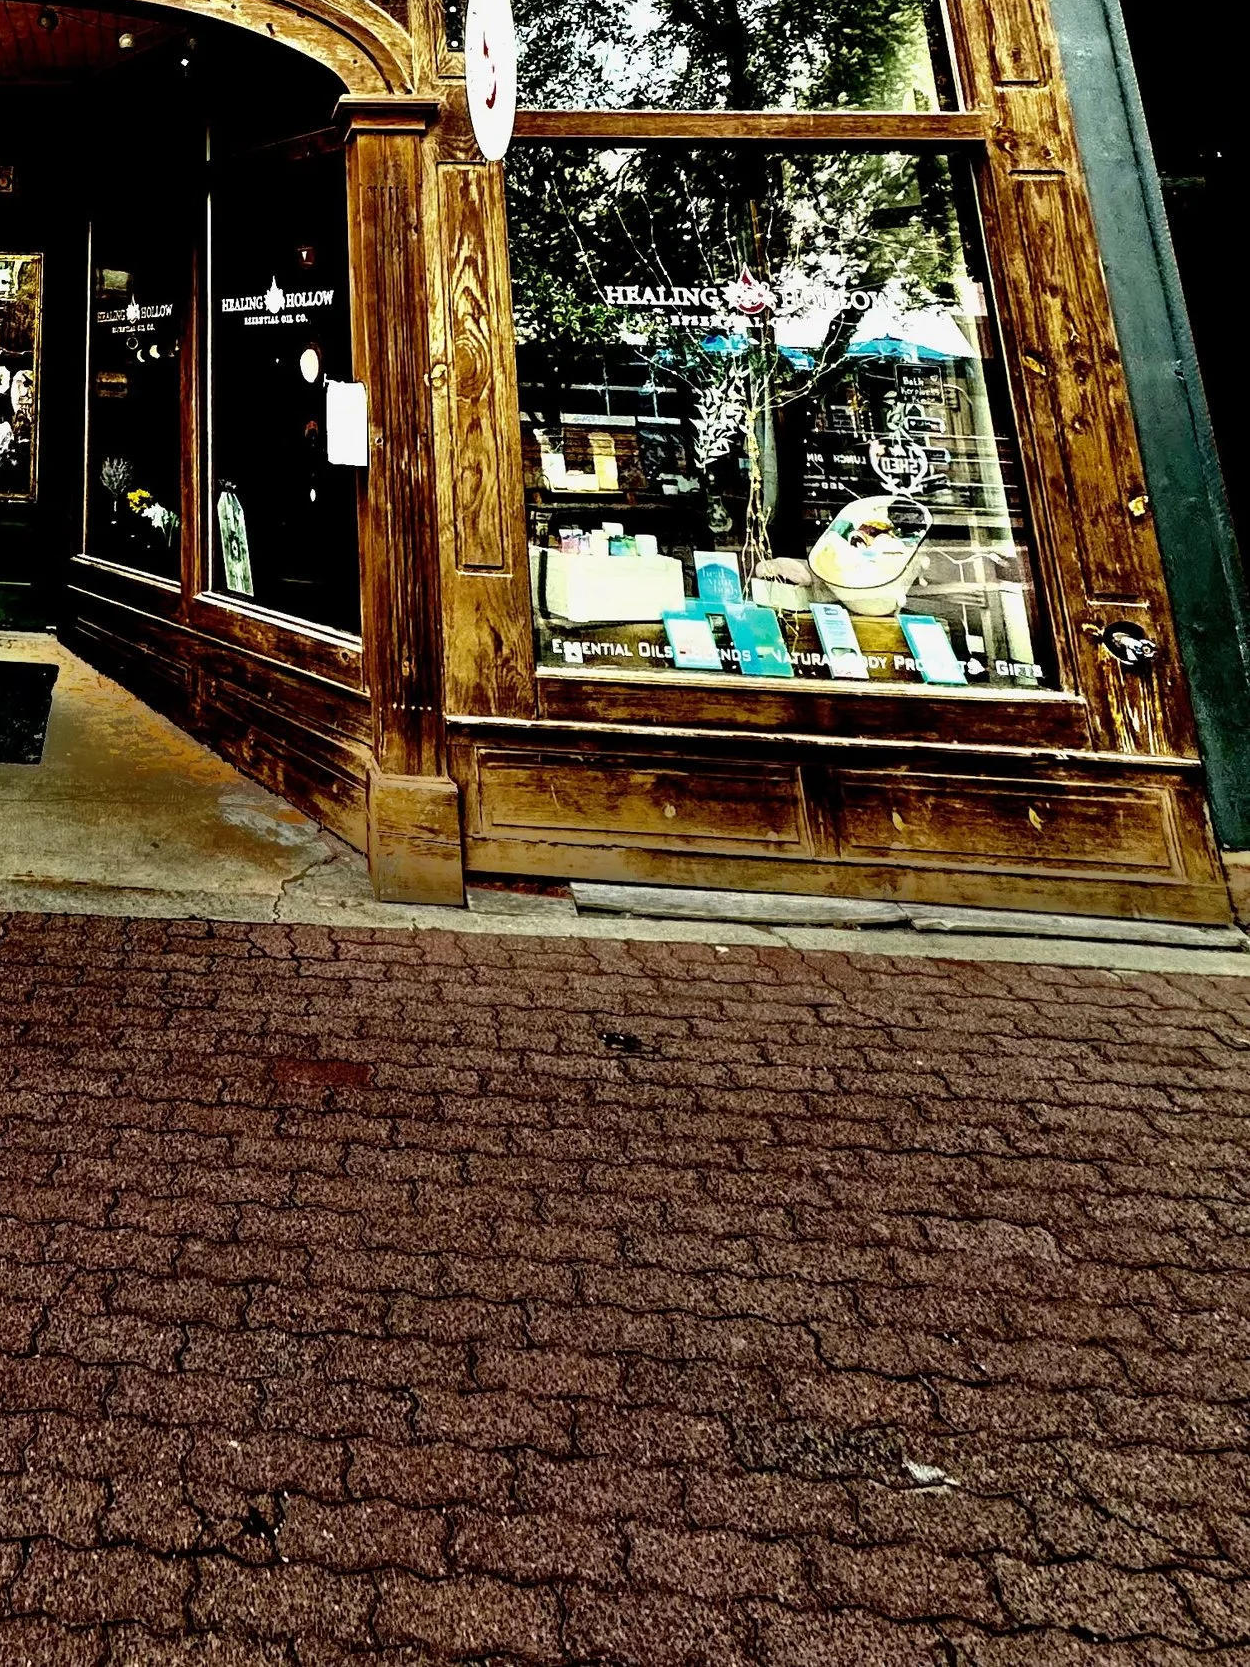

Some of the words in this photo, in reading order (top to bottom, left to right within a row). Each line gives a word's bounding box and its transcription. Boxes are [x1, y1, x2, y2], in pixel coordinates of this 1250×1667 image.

[221, 295, 264, 312] HEALING
[285, 289, 335, 308] HOLLOW
[603, 285, 721, 307] HEALING
[140, 303, 174, 319] HOLLOW
[280, 314, 295, 324] OIL
[295, 313, 309, 323] CO.
[551, 638, 634, 659] EENTIAL
[638, 641, 674, 659] OILS
[770, 649, 838, 667] NATURA
[995, 659, 1044, 678] GIFTS
